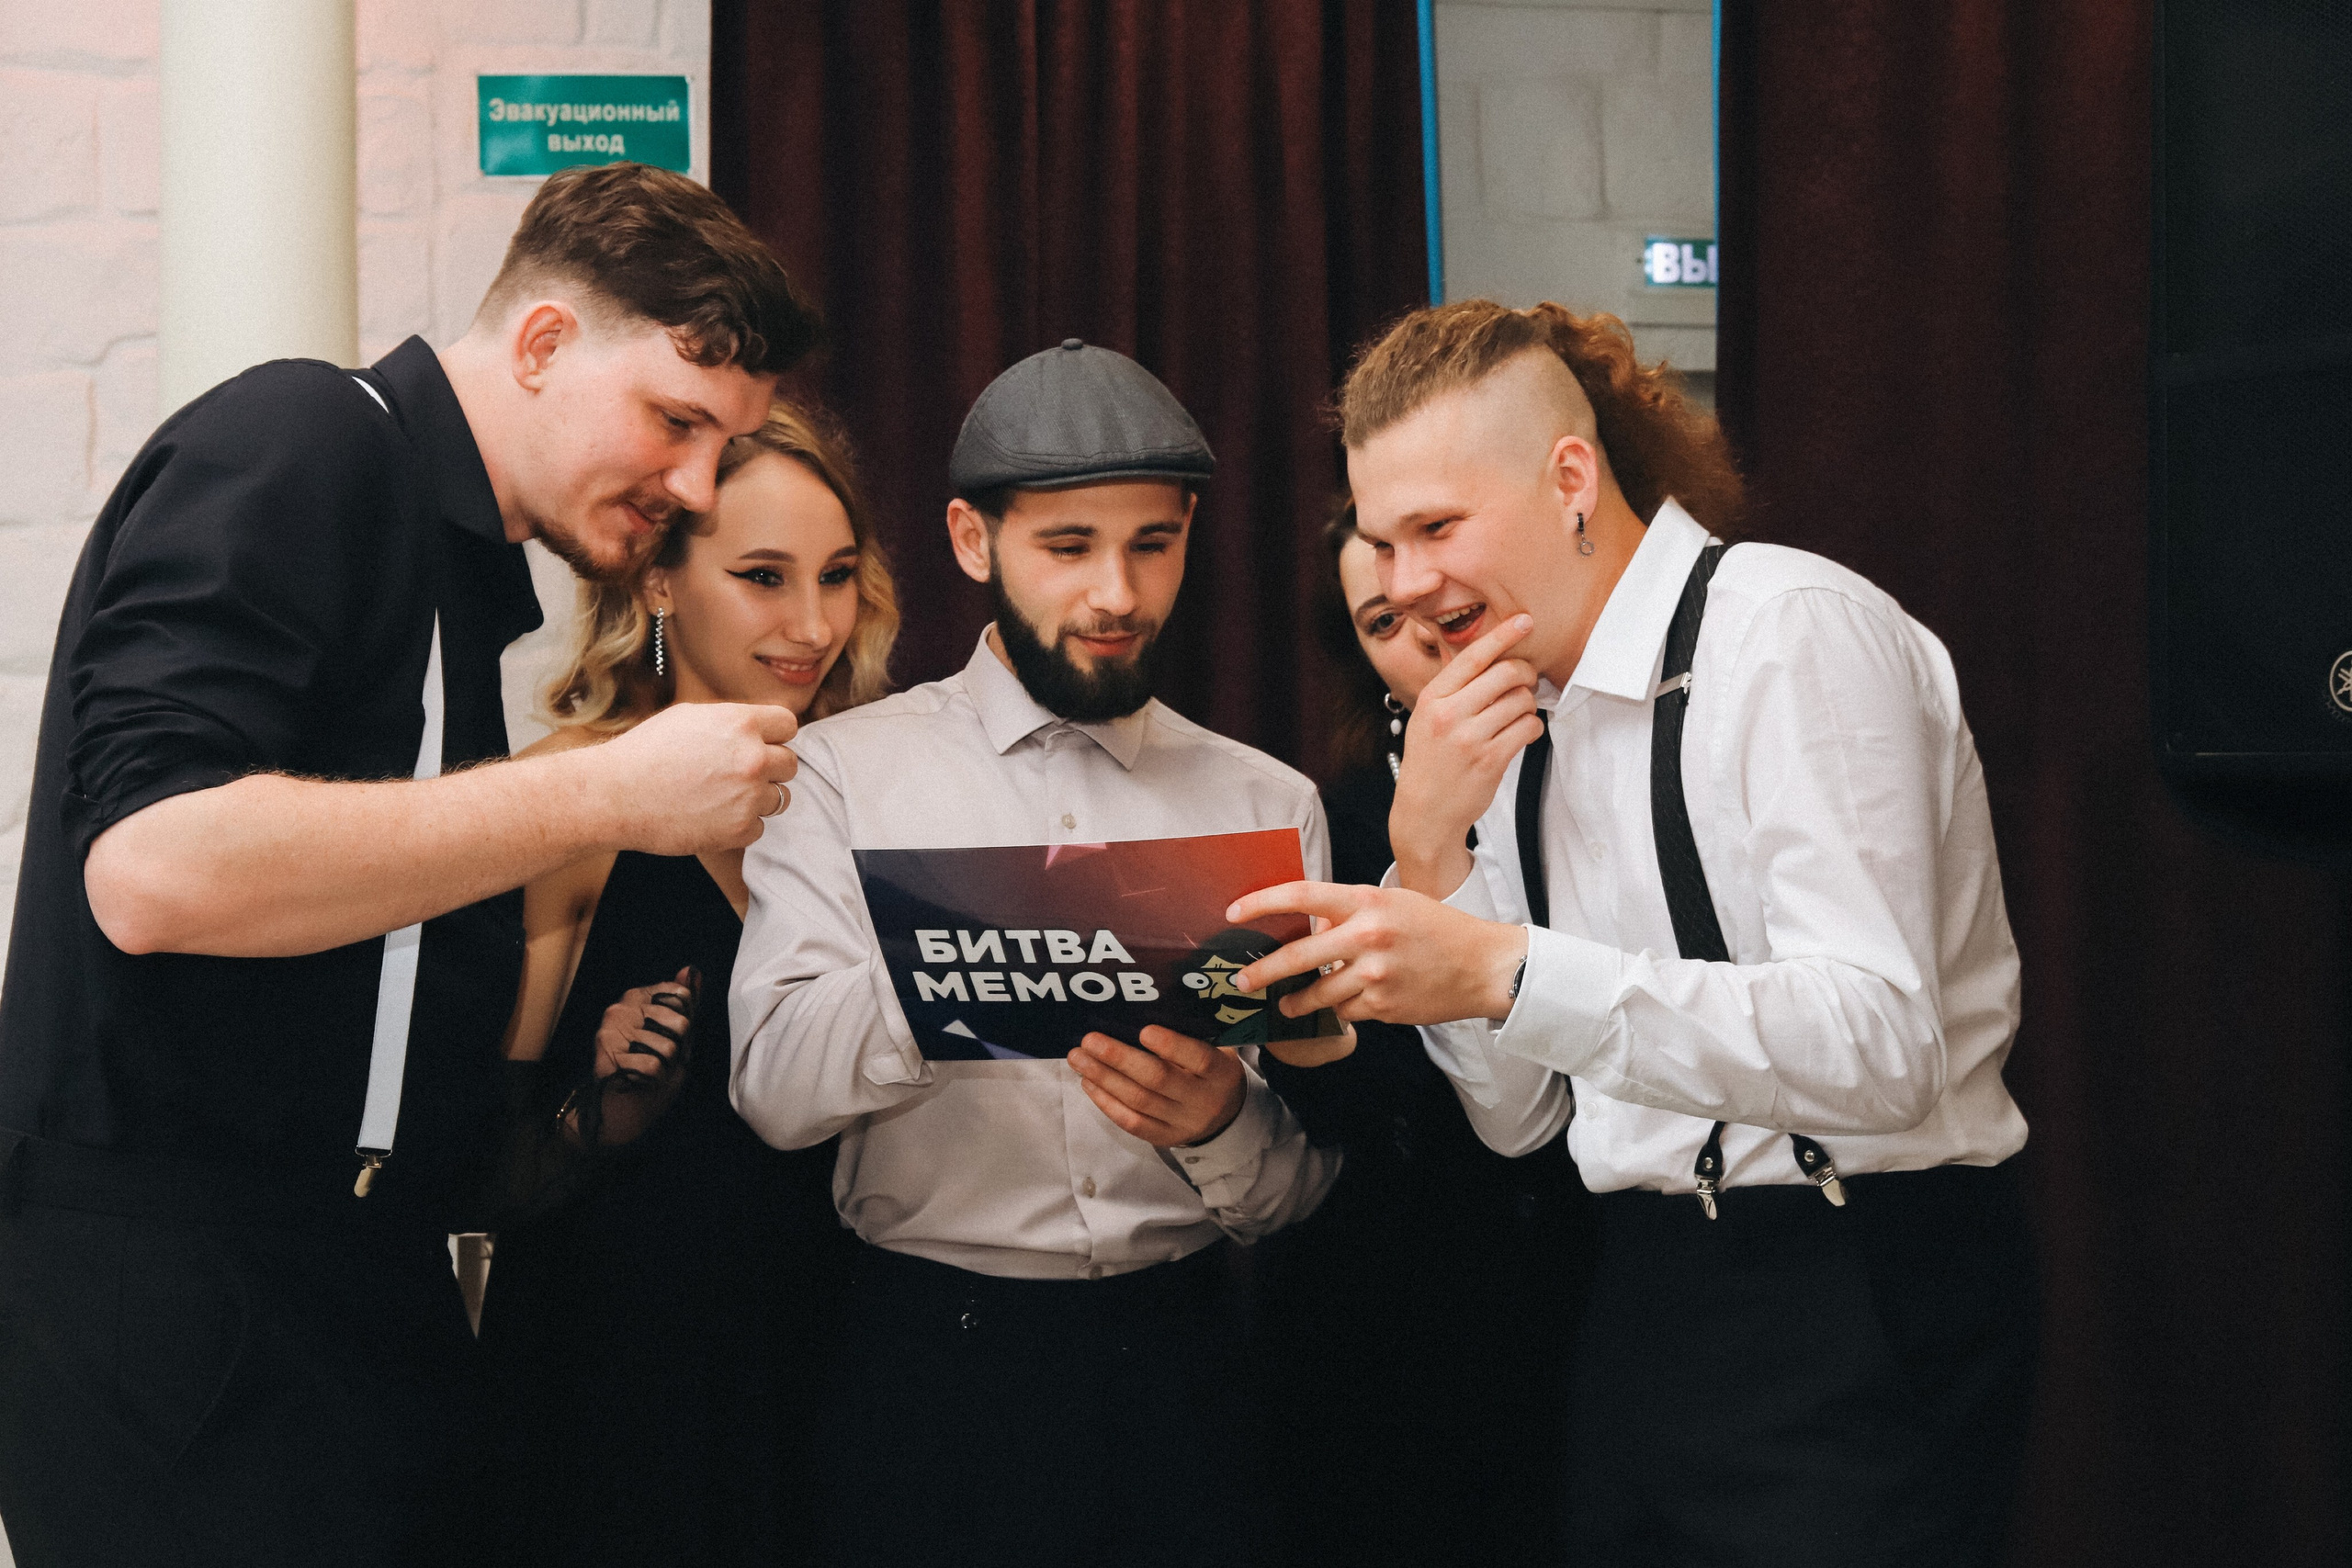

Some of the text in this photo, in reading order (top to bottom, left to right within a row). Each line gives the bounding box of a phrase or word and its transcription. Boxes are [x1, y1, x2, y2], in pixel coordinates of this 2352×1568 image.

[489, 97, 681, 127] Эвакуационный
[548, 133, 626, 154] выход
[914, 929, 1136, 964] БИТВА
[912, 971, 1160, 1002] МЕМОВ
